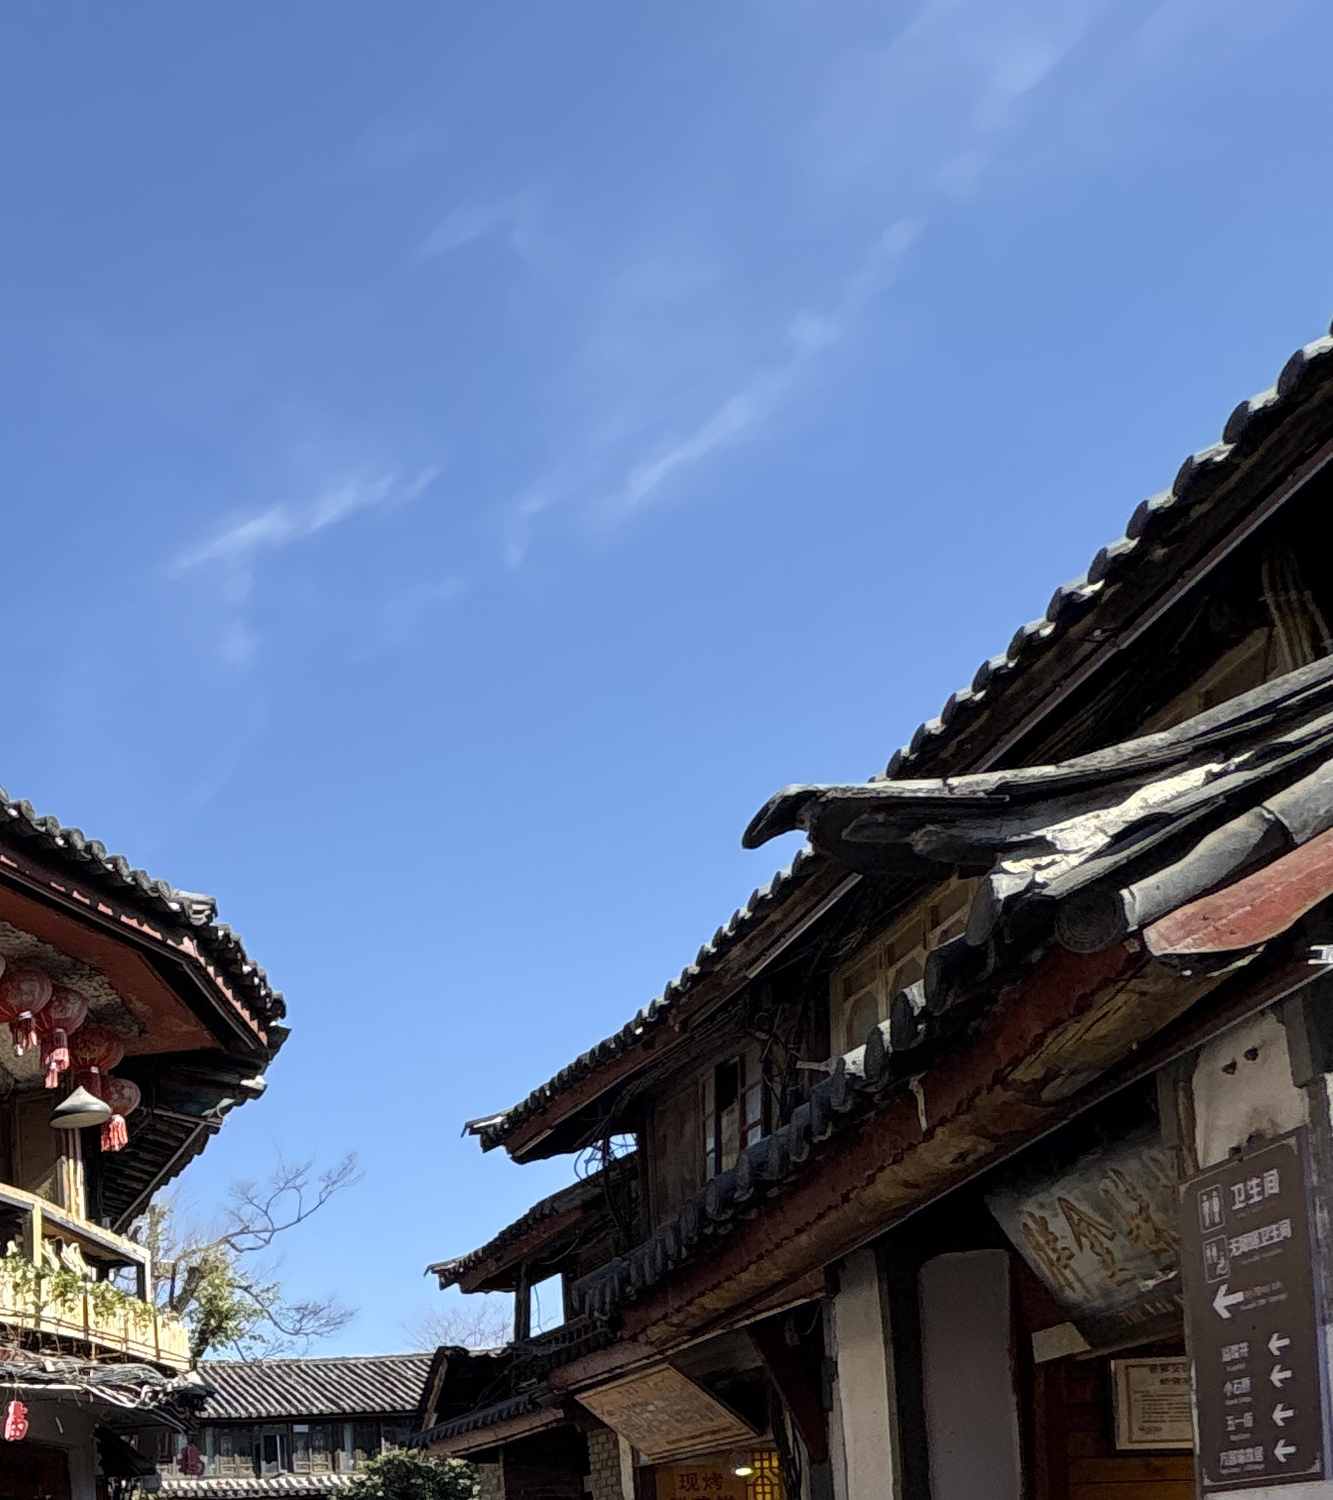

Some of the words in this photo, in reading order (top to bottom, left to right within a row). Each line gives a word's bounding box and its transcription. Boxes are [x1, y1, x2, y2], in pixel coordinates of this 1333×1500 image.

[1230, 1168, 1281, 1211] 卫生间
[677, 1471, 724, 1492] 现烤
